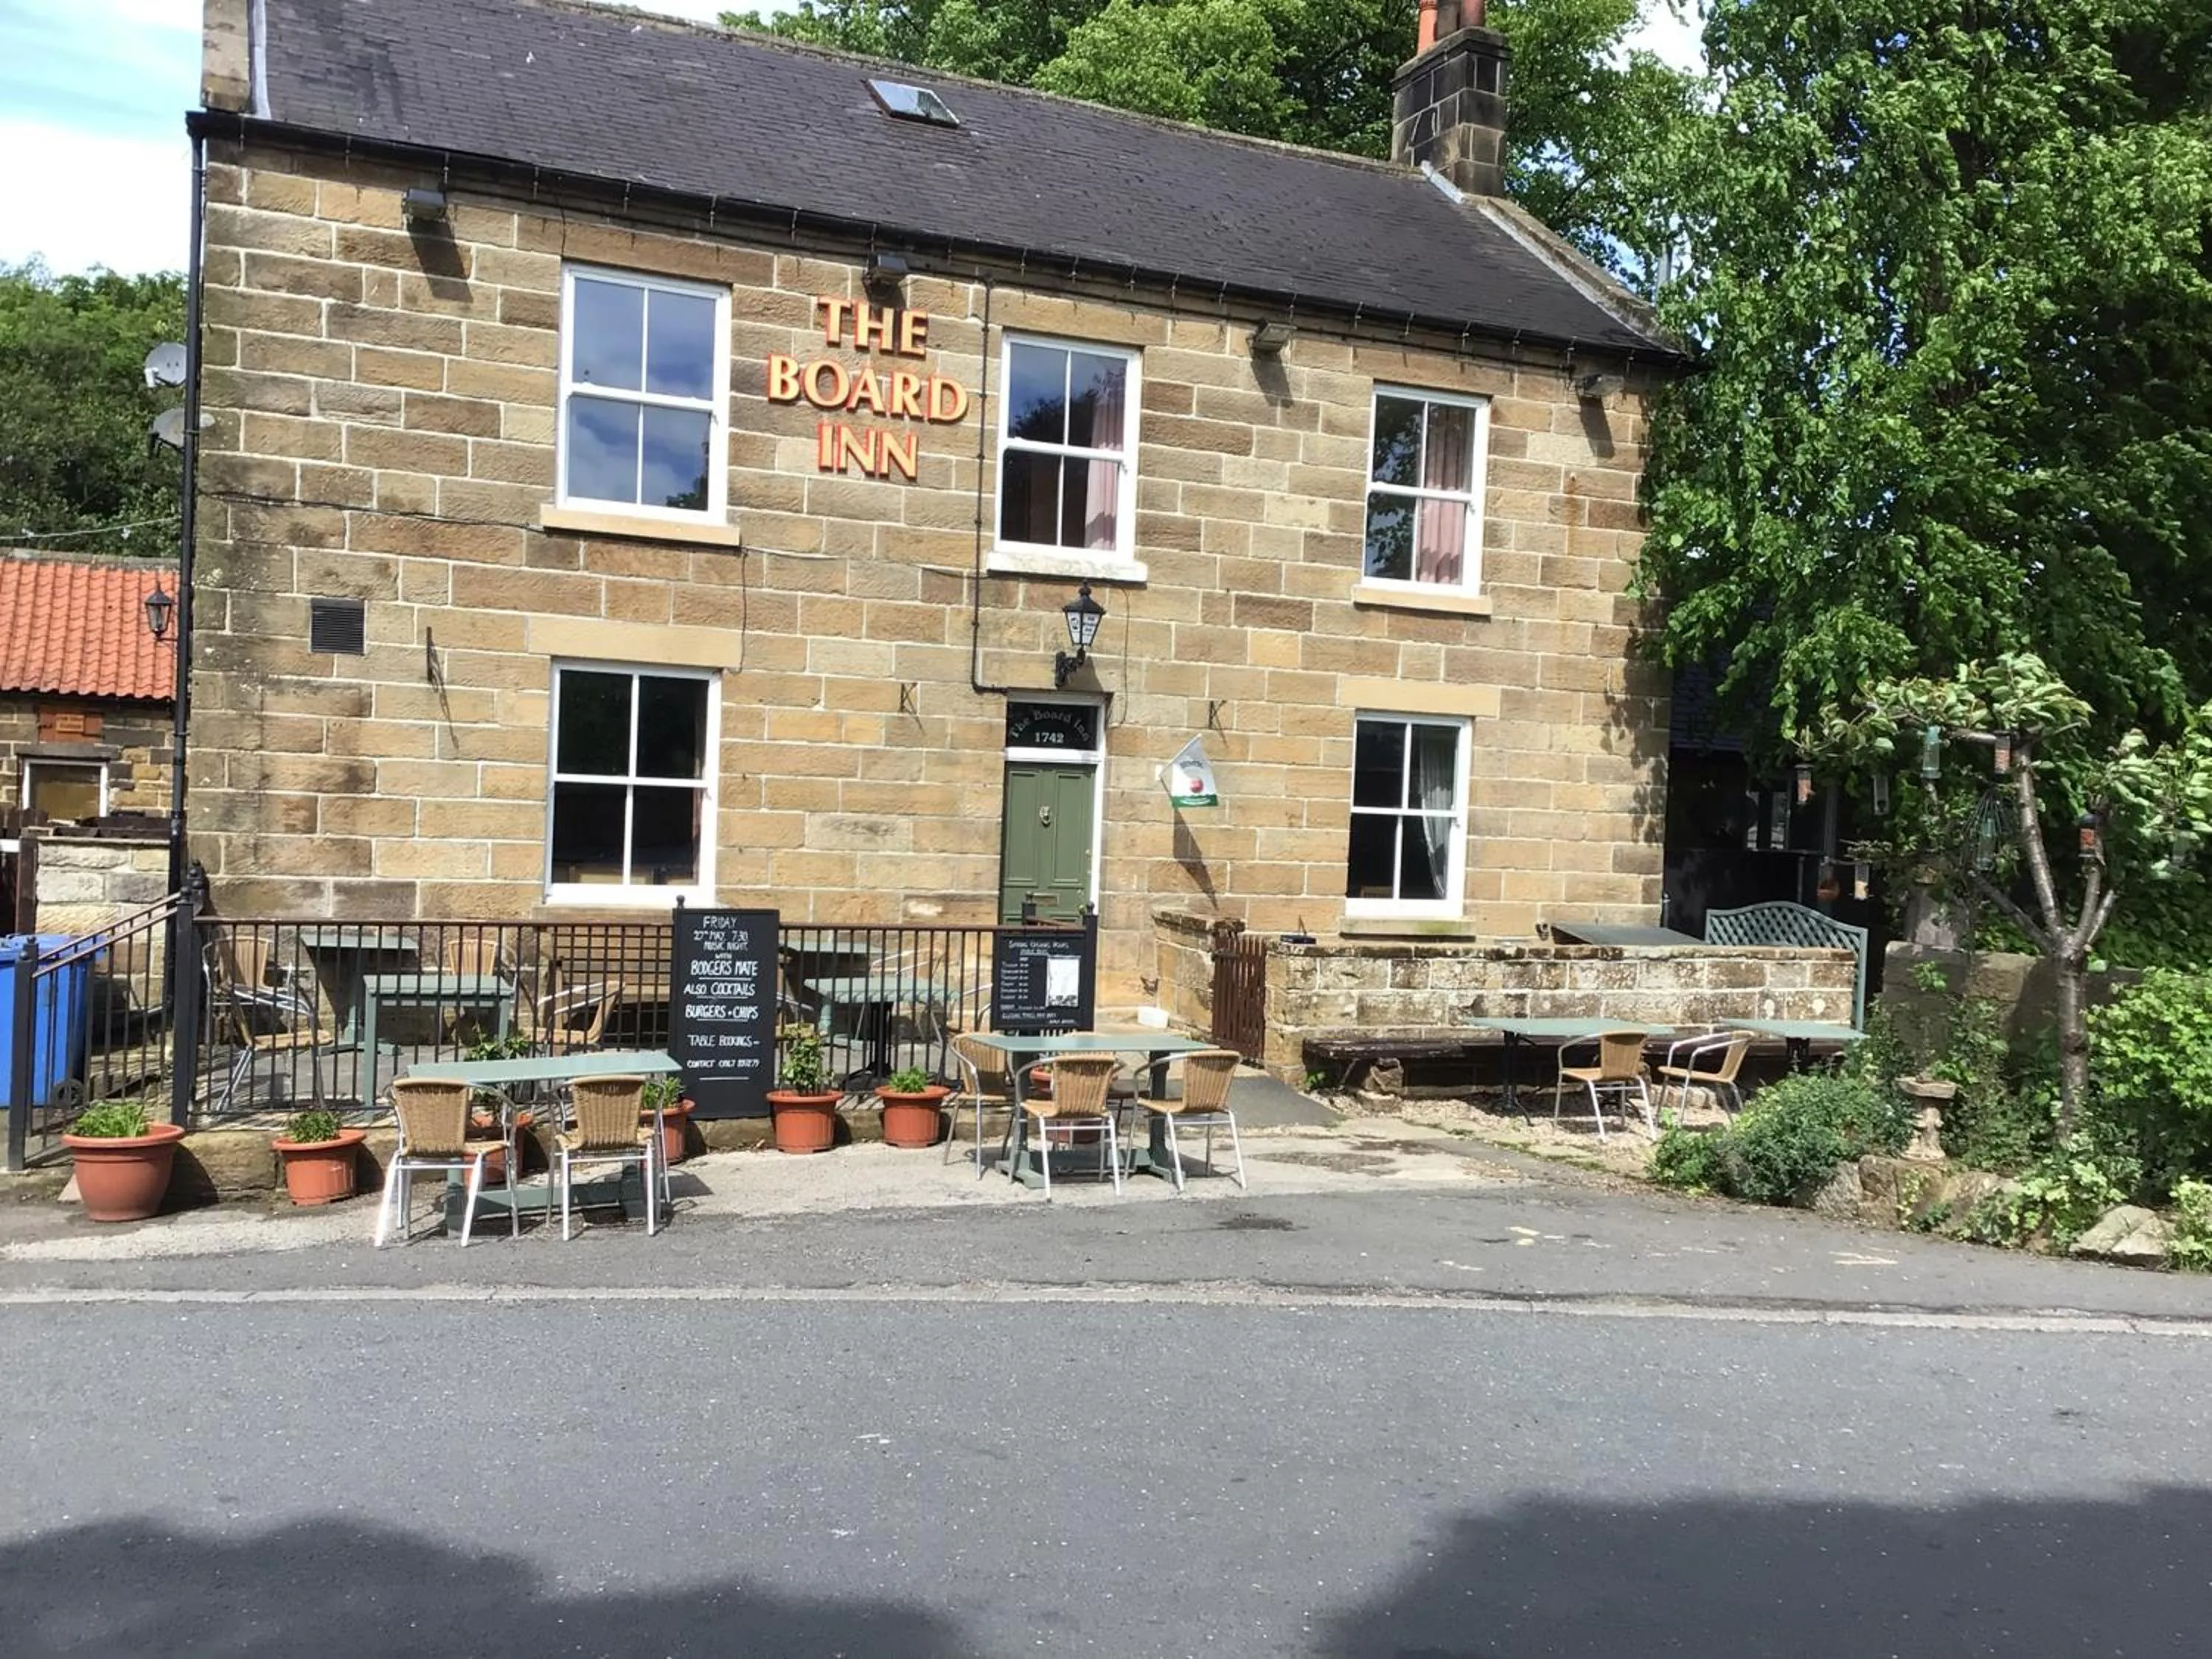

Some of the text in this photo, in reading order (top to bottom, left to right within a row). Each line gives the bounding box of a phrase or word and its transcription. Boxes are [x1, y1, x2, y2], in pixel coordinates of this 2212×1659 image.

[818, 296, 928, 361] THE
[768, 352, 968, 423] BOARD
[817, 422, 917, 481] INN
[1010, 717, 1030, 738] The
[1033, 710, 1072, 723] Board
[1034, 731, 1064, 743] 1742
[703, 915, 737, 929] FRIDAY
[734, 961, 759, 976] MATE
[684, 981, 756, 996] ALSO COCKTAILS
[685, 1004, 759, 1020] BURGERS CHIPS
[687, 1034, 716, 1047] TABLE
